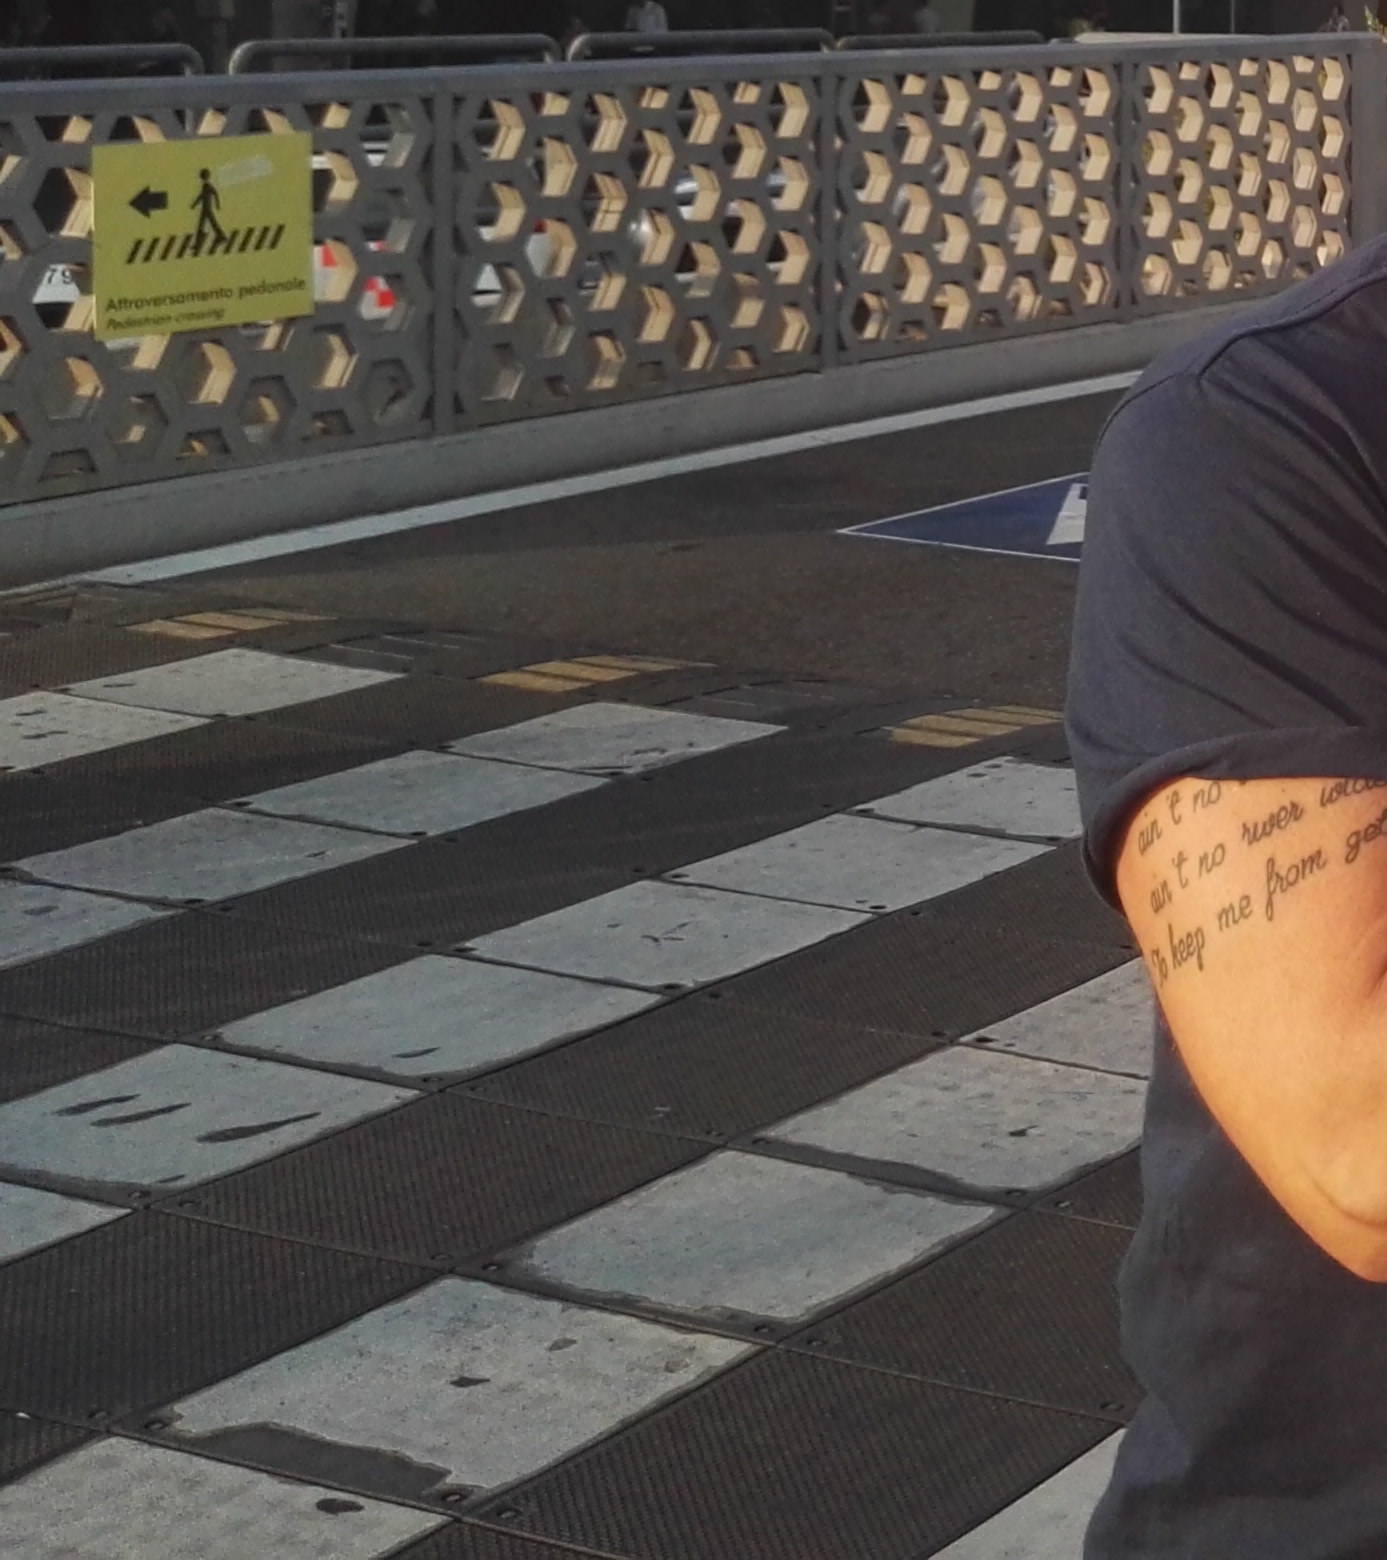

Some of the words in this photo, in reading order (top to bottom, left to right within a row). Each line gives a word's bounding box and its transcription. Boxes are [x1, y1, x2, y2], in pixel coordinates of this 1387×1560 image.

[237, 277, 307, 301] pedonale
[1192, 780, 1222, 814] no
[1198, 842, 1226, 878] no
[1240, 800, 1304, 847] river
[1168, 923, 1206, 973] keep
[1216, 893, 1253, 933] me
[1264, 849, 1328, 923] from
